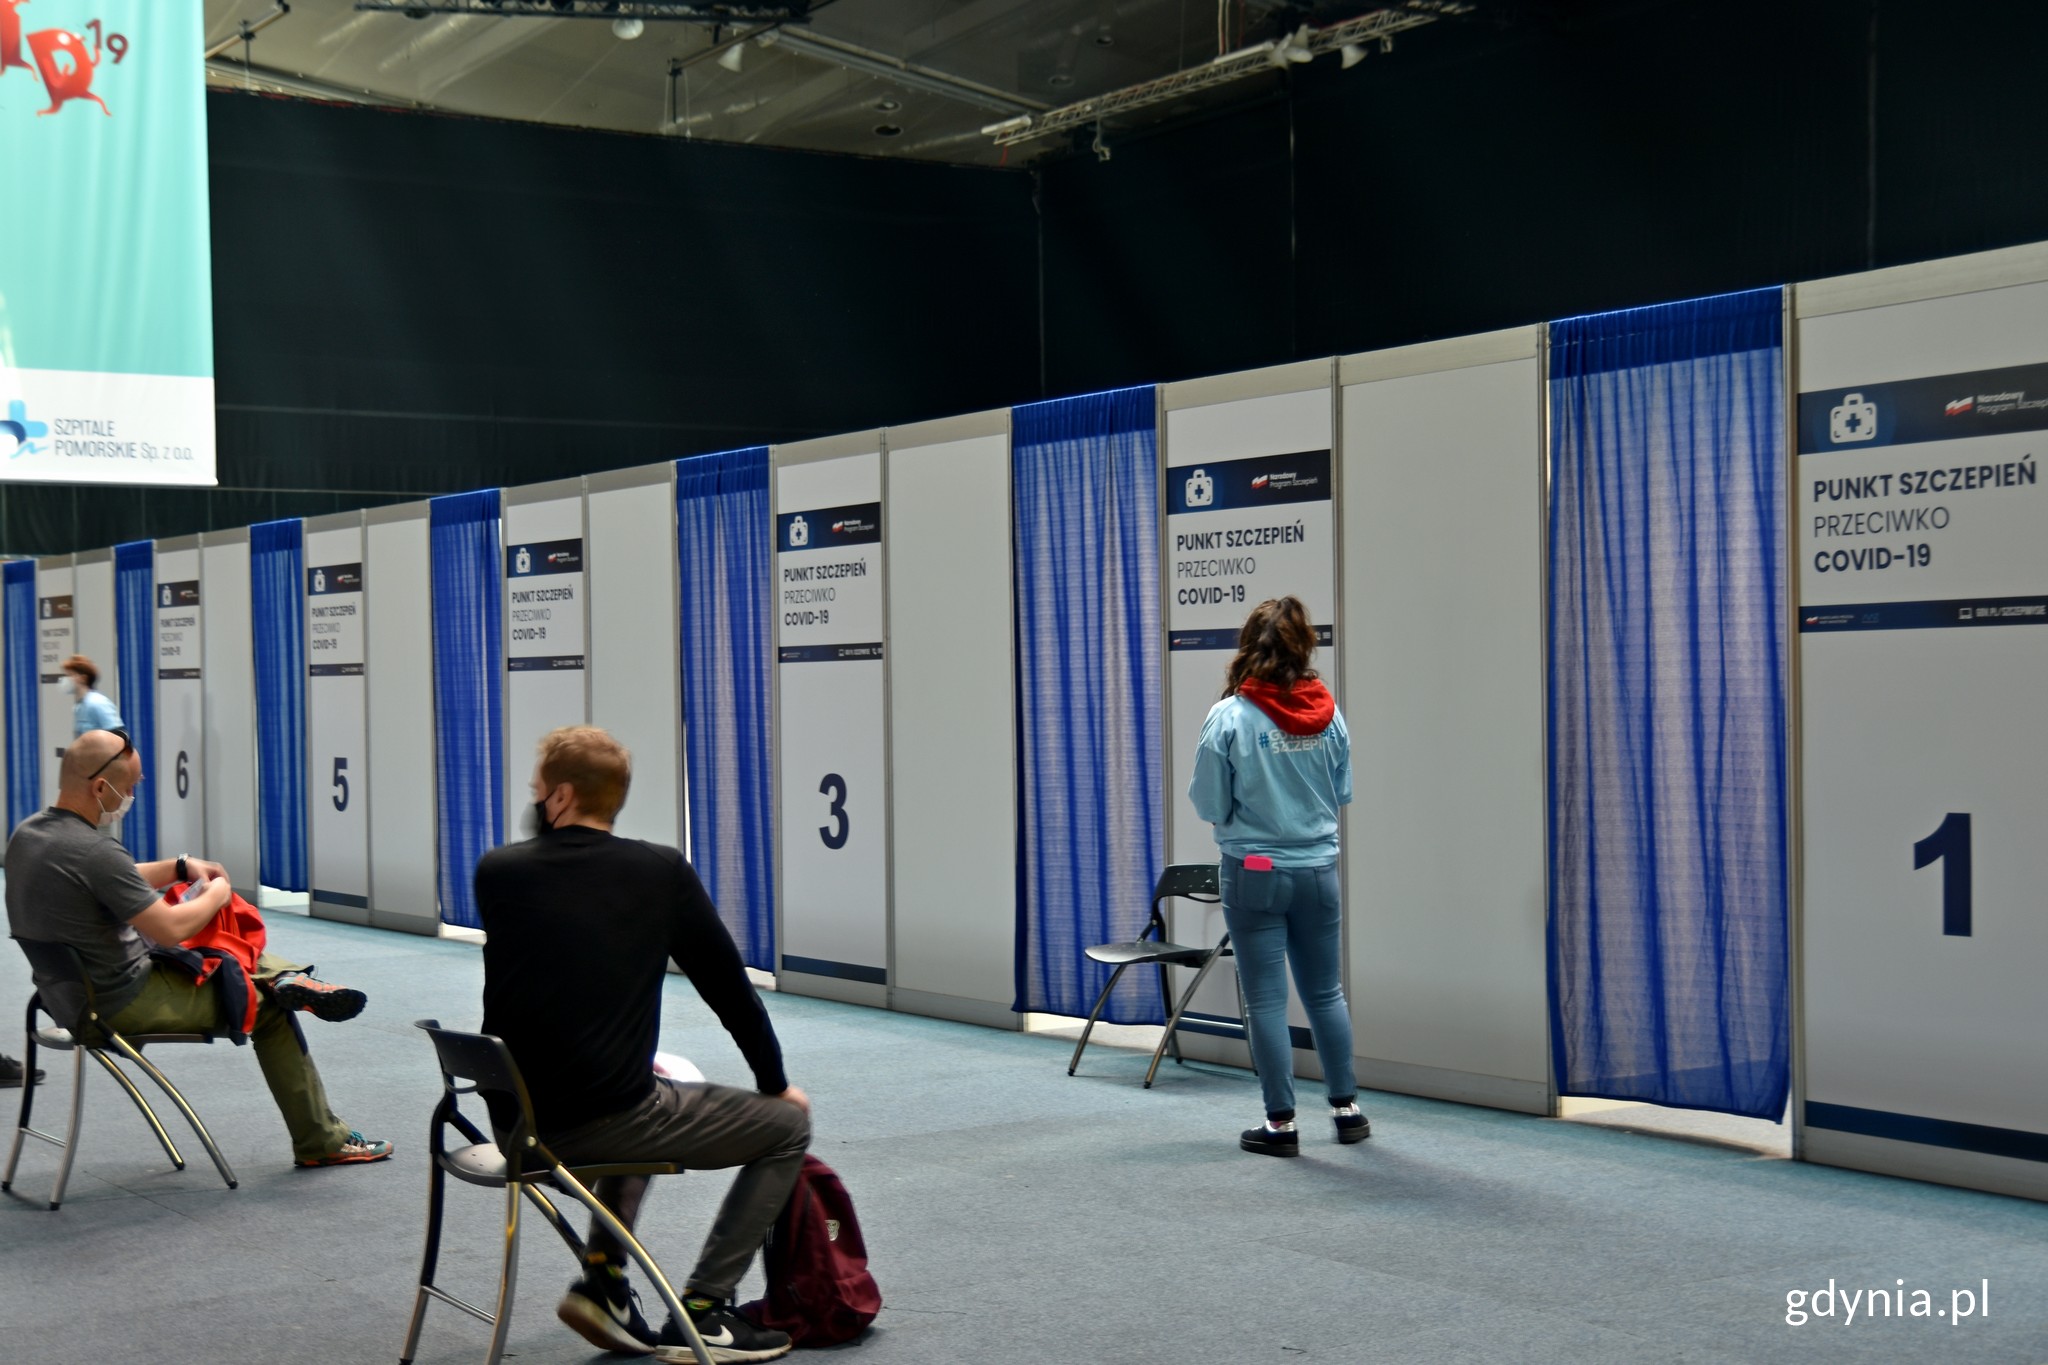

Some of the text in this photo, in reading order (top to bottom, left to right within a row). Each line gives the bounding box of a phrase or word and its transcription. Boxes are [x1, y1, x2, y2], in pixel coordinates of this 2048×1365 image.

[54, 418, 115, 437] SZPITALE
[55, 440, 137, 458] POMORSKIE
[1813, 453, 2036, 502] PUNKT SZCZEPIEŃ
[1814, 506, 1949, 538] PRZECIWKO
[1177, 519, 1304, 552] PUNKT SZCZEPIEŃ
[784, 557, 866, 582] PUNKT SZCZEPIEŃ
[1178, 557, 1256, 578] PRZECIWKO
[1814, 543, 1931, 573] COVID-19
[512, 591, 535, 603] PUNKT
[784, 587, 836, 604] PRZECIWKO
[1178, 584, 1245, 605] COVID-19
[784, 609, 829, 626] COVID-19
[512, 627, 546, 640] COVID-19
[176, 750, 189, 800] 6
[333, 757, 349, 812] 5
[819, 772, 850, 850] 3
[1913, 812, 1972, 937] 1
